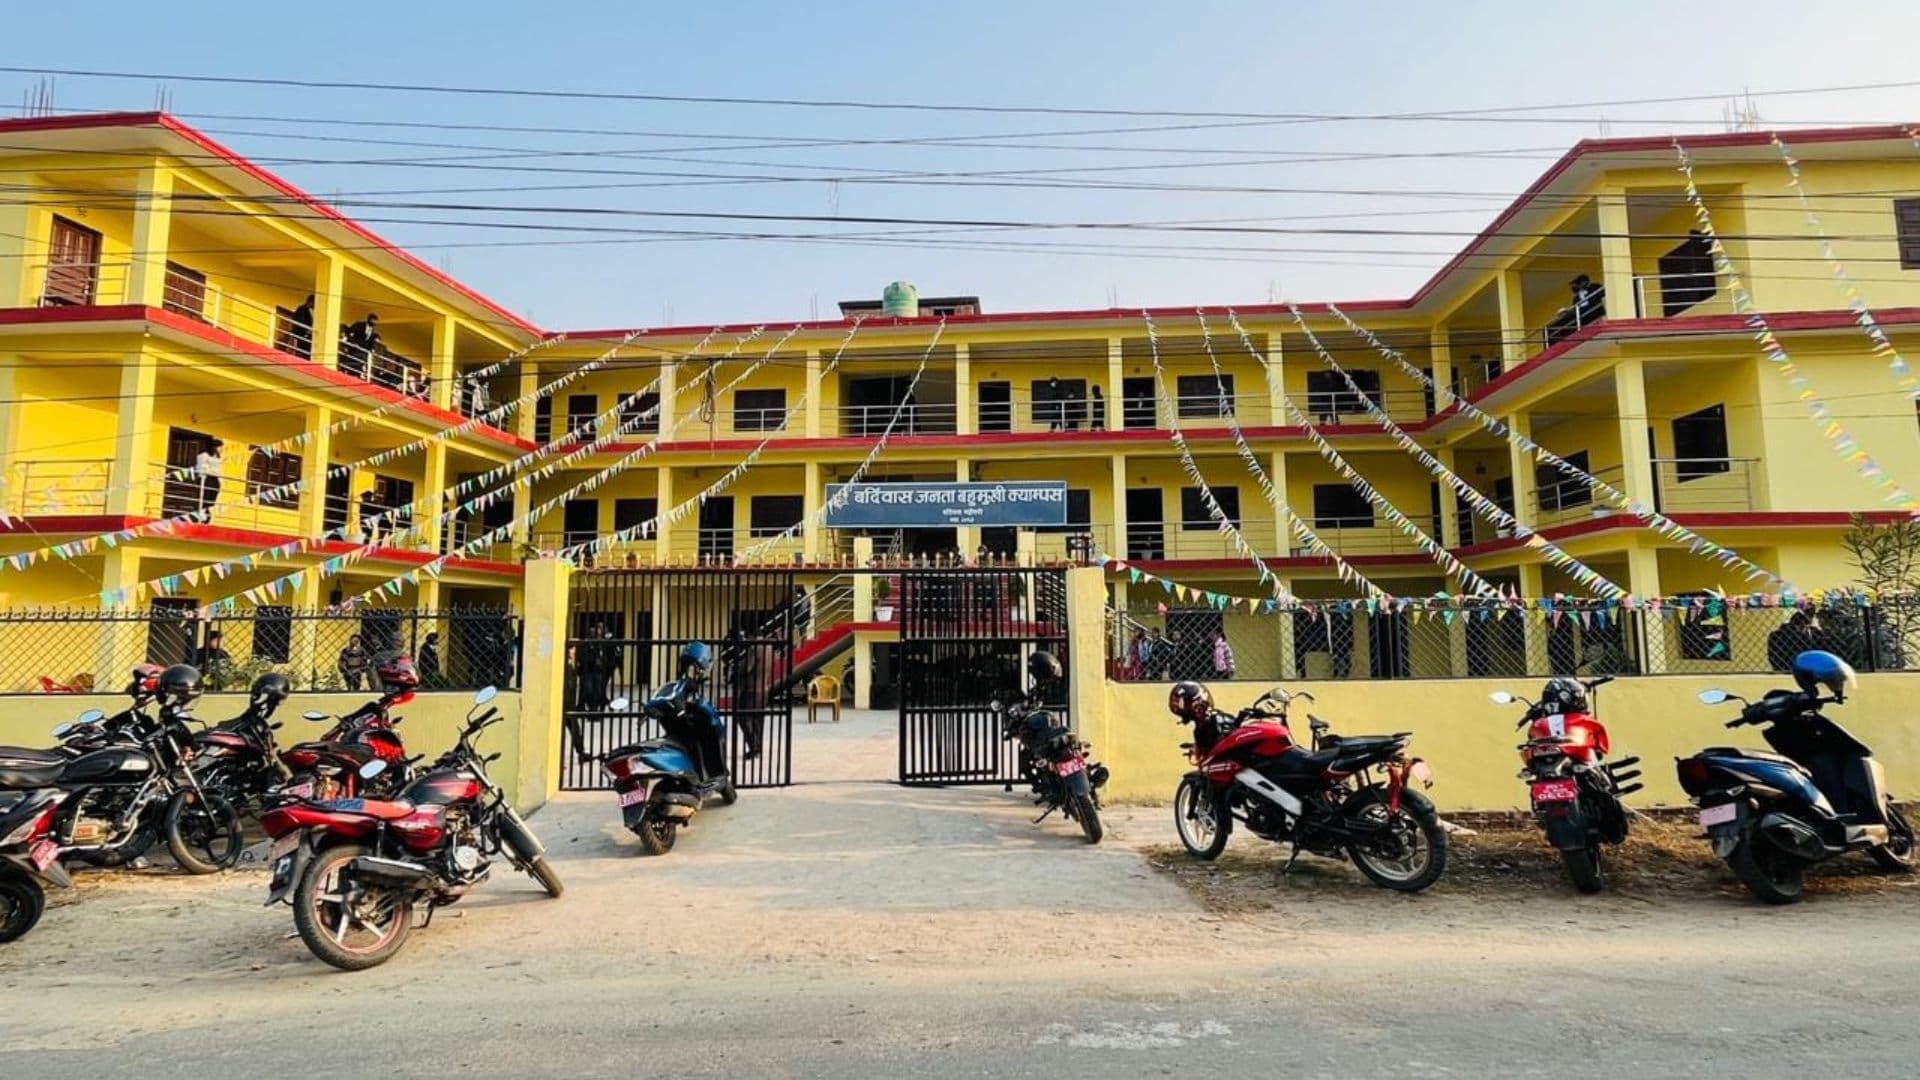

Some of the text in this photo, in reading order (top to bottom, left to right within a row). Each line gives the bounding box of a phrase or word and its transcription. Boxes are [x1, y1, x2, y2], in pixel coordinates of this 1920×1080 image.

[914, 489, 956, 504] जनता
[957, 485, 1007, 507] बहुमुखी
[1008, 487, 1064, 503] क्याम्पस
